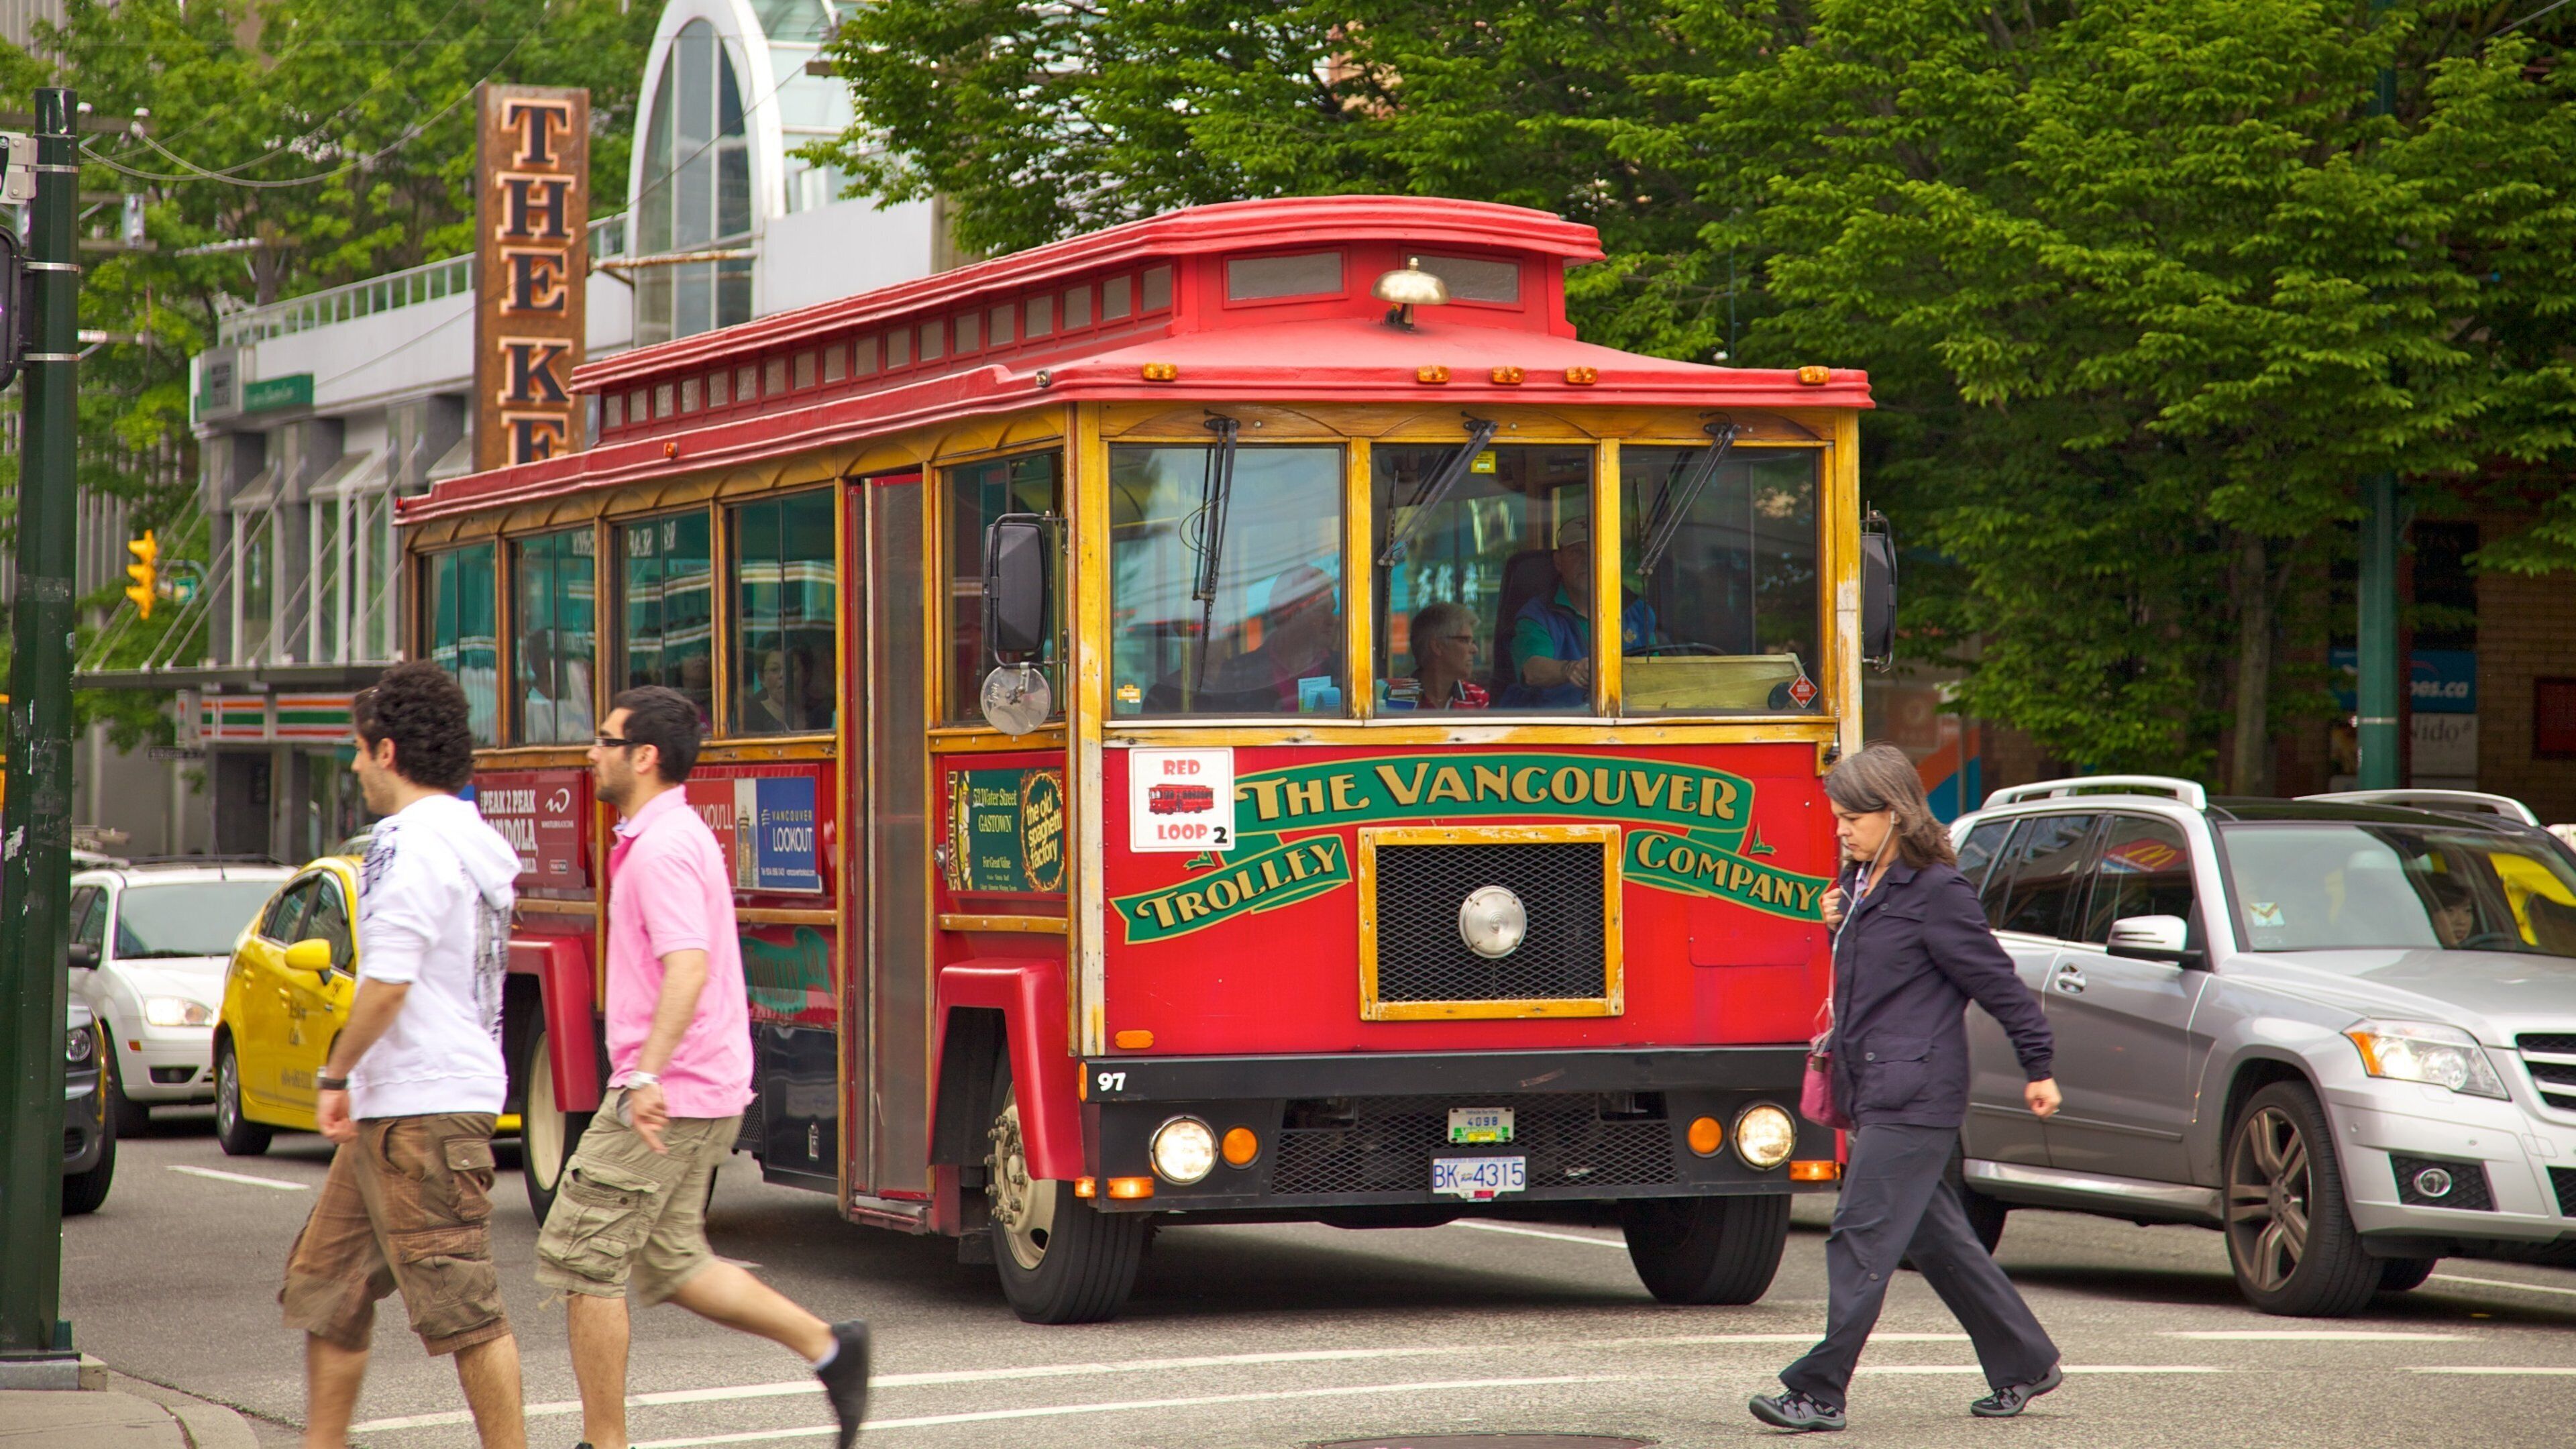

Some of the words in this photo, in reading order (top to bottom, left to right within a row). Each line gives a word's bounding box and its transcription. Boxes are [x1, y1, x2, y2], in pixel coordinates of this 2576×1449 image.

[494, 97, 576, 318] THE
[1163, 759, 1200, 775] RED
[483, 790, 505, 814] PEAK
[506, 790, 511, 814] 2
[513, 790, 536, 814] PEAK
[981, 788, 999, 806] Water
[1000, 788, 1018, 806] Street
[1234, 773, 1371, 822] THE
[1375, 762, 1739, 821] VANCOUVER
[703, 804, 733, 830] YOU'LL
[772, 810, 812, 822] VANCOUVER
[1026, 802, 1039, 826] the
[1040, 788, 1053, 817] old
[978, 814, 1012, 833] GASTOWN
[1028, 808, 1063, 849] spaghetti
[1158, 824, 1208, 840] LOOP
[1214, 826, 1228, 843] 2
[485, 818, 539, 857] DOLA,
[772, 826, 812, 853] LOOKOUT
[1030, 839, 1058, 869] factory
[1134, 842, 1339, 930] TROLLEY
[1636, 833, 1821, 913] COMPANY
[1097, 1072, 1126, 1091] 97
[1467, 1116, 1499, 1126] 4098
[1433, 1164, 1458, 1188] BK
[1472, 1163, 1525, 1187] 4315
